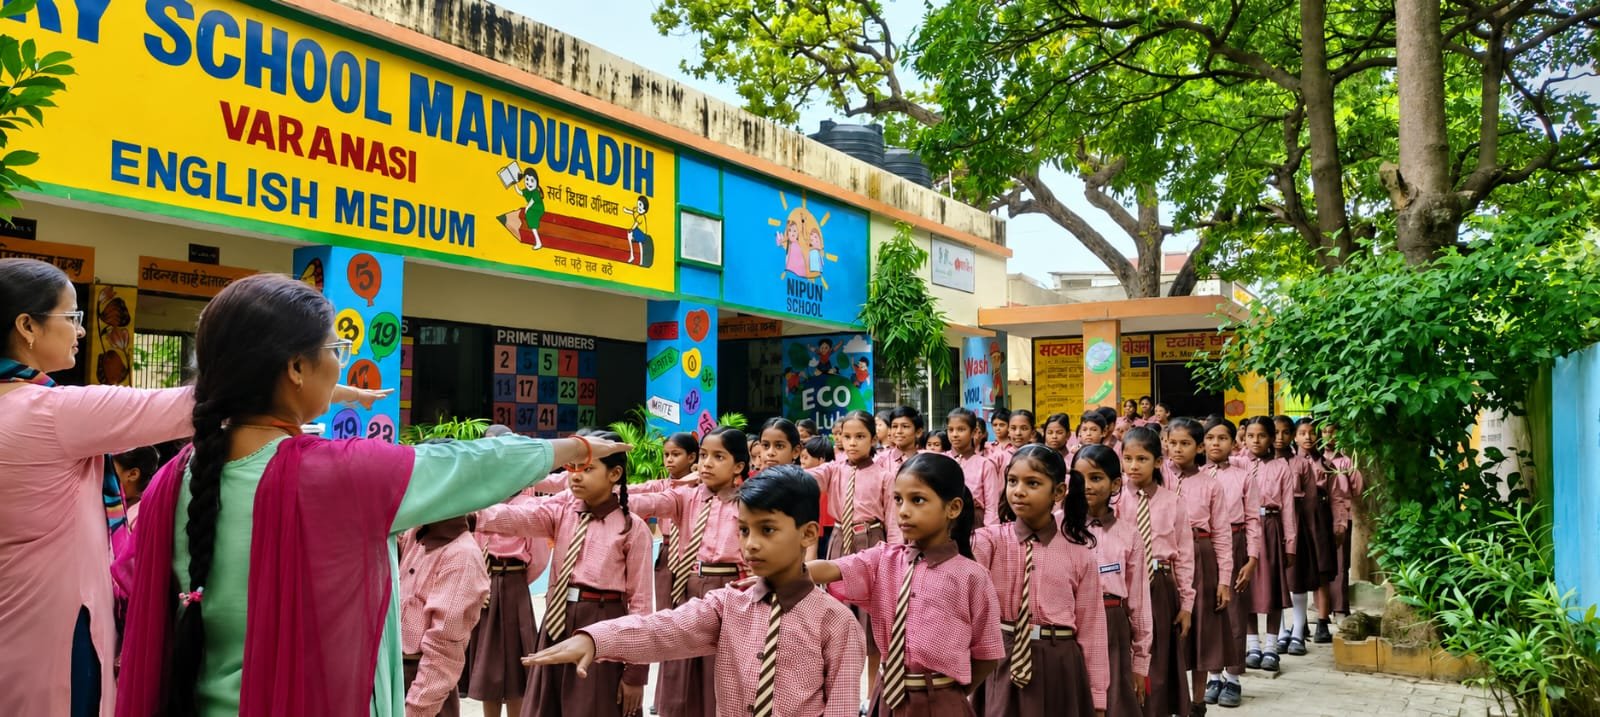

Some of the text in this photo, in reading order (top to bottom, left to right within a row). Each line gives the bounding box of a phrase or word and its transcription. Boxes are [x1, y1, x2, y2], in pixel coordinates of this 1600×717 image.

[144, 0, 392, 125] SCHOOL
[408, 72, 654, 198] MANDUADIH
[219, 100, 417, 183] VARANASI
[111, 139, 475, 248] ENGLISH MEDIUM
[355, 262, 374, 291] 5
[786, 277, 823, 302] NIPUN
[786, 298, 823, 318] SCHOOL
[338, 316, 359, 342] 3
[371, 322, 398, 347] 19
[497, 329, 595, 350] PRIME NUMBERS
[500, 351, 509, 368] 2
[543, 353, 553, 371] 5
[565, 355, 573, 371] 7
[964, 354, 989, 379] Wash
[518, 380, 534, 397] 17
[560, 381, 576, 398] 23
[580, 382, 595, 399] 29
[802, 385, 851, 411] ECO
[497, 407, 512, 425] 31
[518, 408, 534, 426] 37
[539, 408, 555, 426] 41
[580, 409, 595, 426] 47
